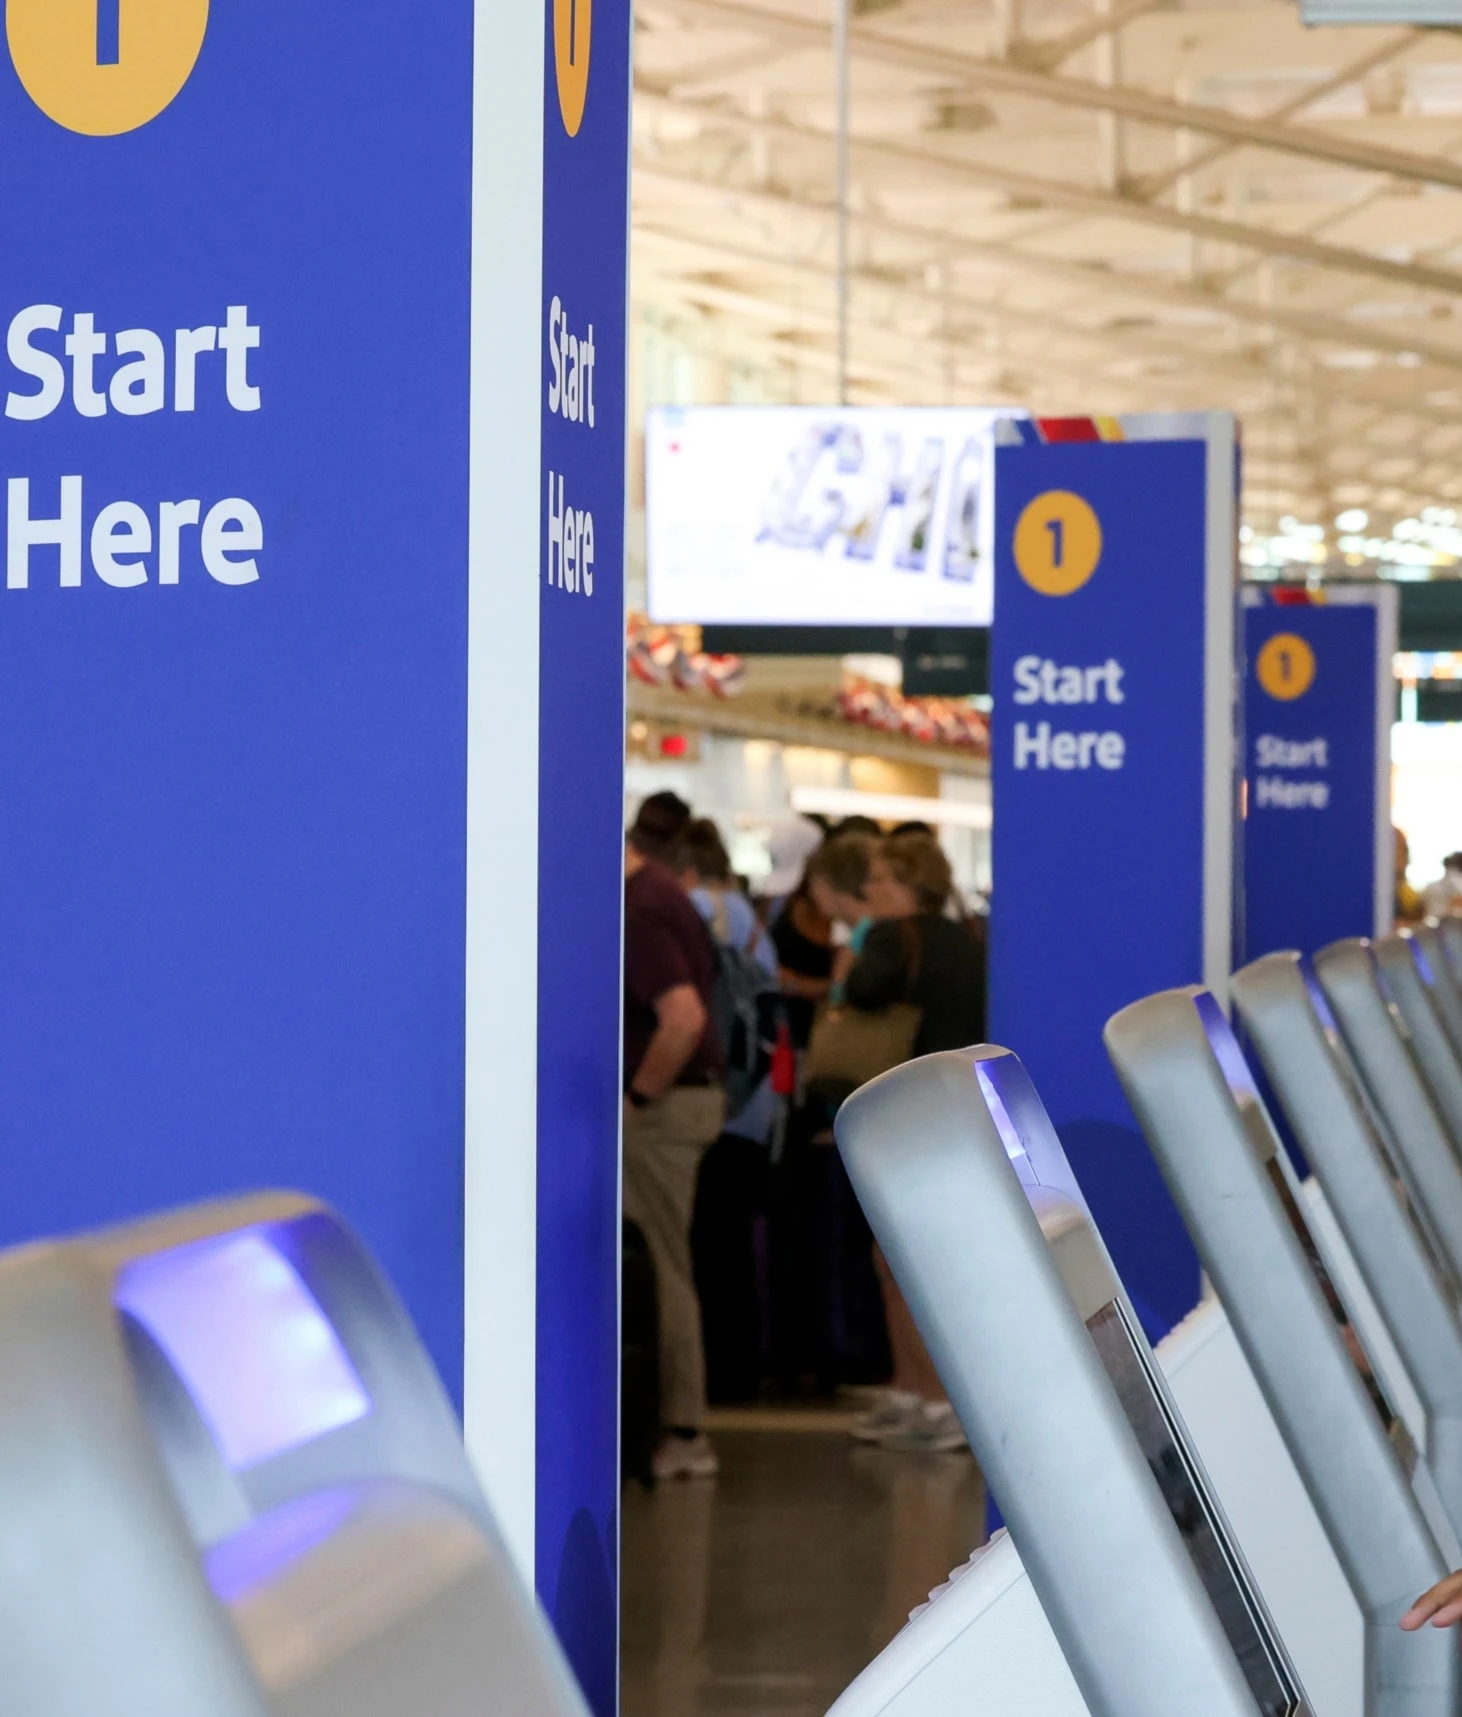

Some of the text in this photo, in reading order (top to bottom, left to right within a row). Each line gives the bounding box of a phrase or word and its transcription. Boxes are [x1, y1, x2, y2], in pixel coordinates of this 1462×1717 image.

[4, 304, 261, 421] Start
[548, 296, 595, 428] Start
[6, 475, 264, 589] Here
[548, 471, 594, 596] Here
[1045, 519, 1064, 568] 1
[1013, 655, 1124, 705] Start
[1278, 651, 1292, 682] 1
[1014, 721, 1125, 770] Here
[1256, 735, 1328, 768] Start
[1256, 777, 1329, 809] Here
